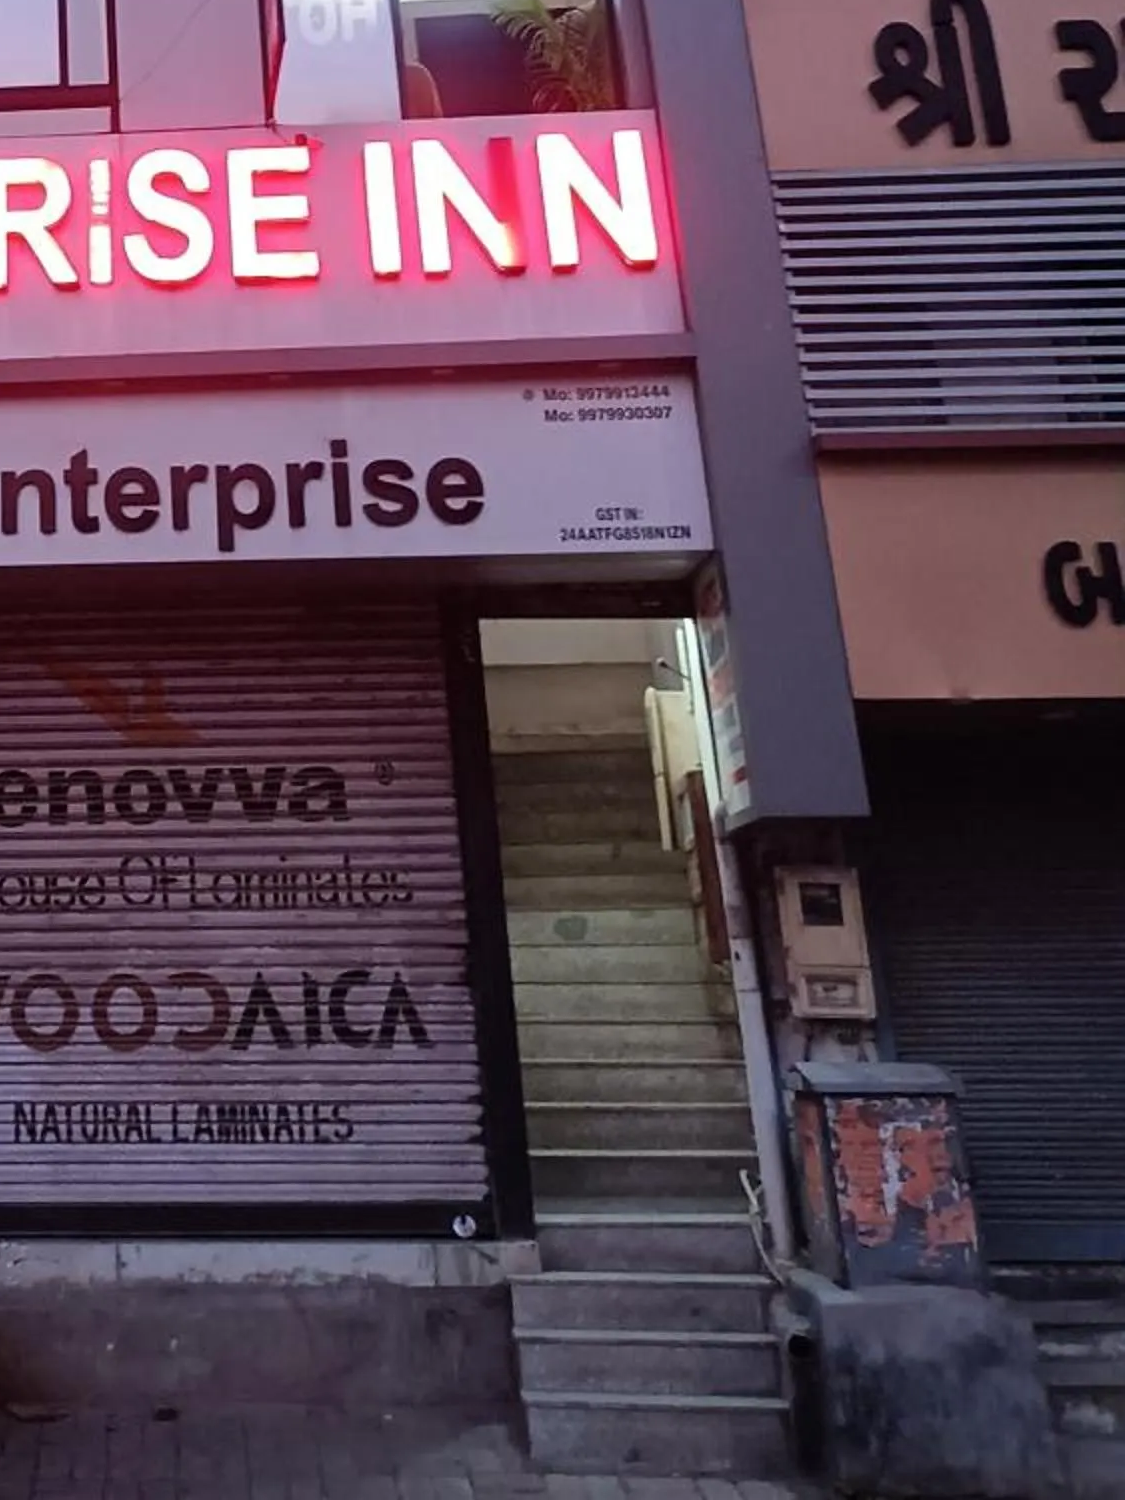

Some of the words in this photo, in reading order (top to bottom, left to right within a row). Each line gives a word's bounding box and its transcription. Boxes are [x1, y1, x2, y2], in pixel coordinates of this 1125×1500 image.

[363, 129, 660, 282] INN
[13, 1099, 162, 1144] NATURAL
[173, 1097, 355, 1144] LAMINATES
